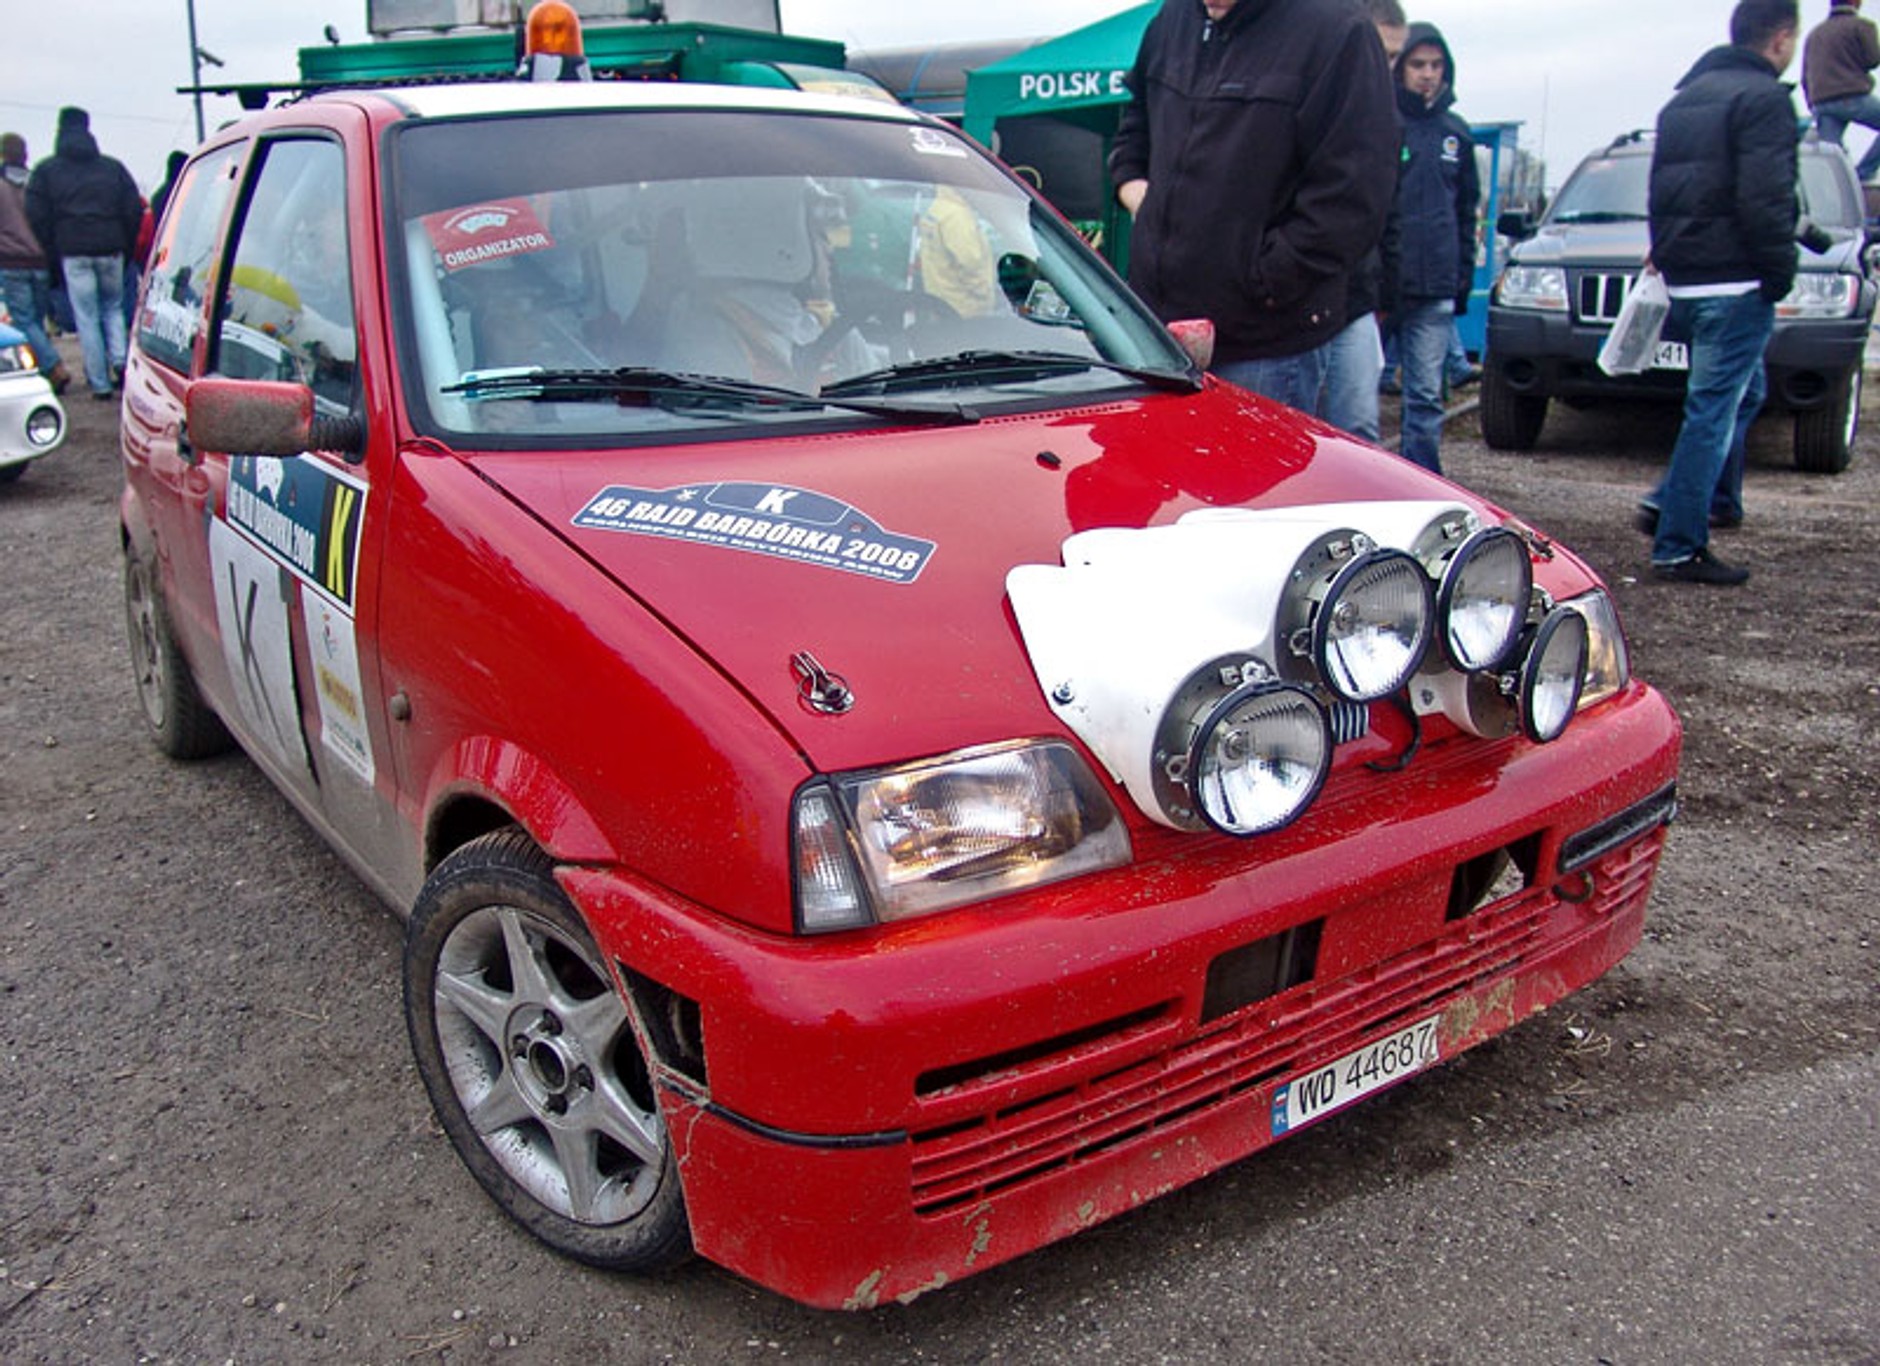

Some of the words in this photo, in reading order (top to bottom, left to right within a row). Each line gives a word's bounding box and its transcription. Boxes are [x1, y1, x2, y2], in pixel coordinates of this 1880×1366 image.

[445, 233, 548, 266] ORGANIZATOR
[327, 483, 354, 598] K
[588, 496, 623, 517] 46
[626, 502, 699, 528] RAJD
[695, 511, 842, 554] BARBÓRKA
[841, 540, 921, 572] 2008
[754, 488, 798, 514] K
[228, 561, 286, 753] K
[1299, 1067, 1336, 1114] WD
[1346, 1023, 1432, 1089] 44687
